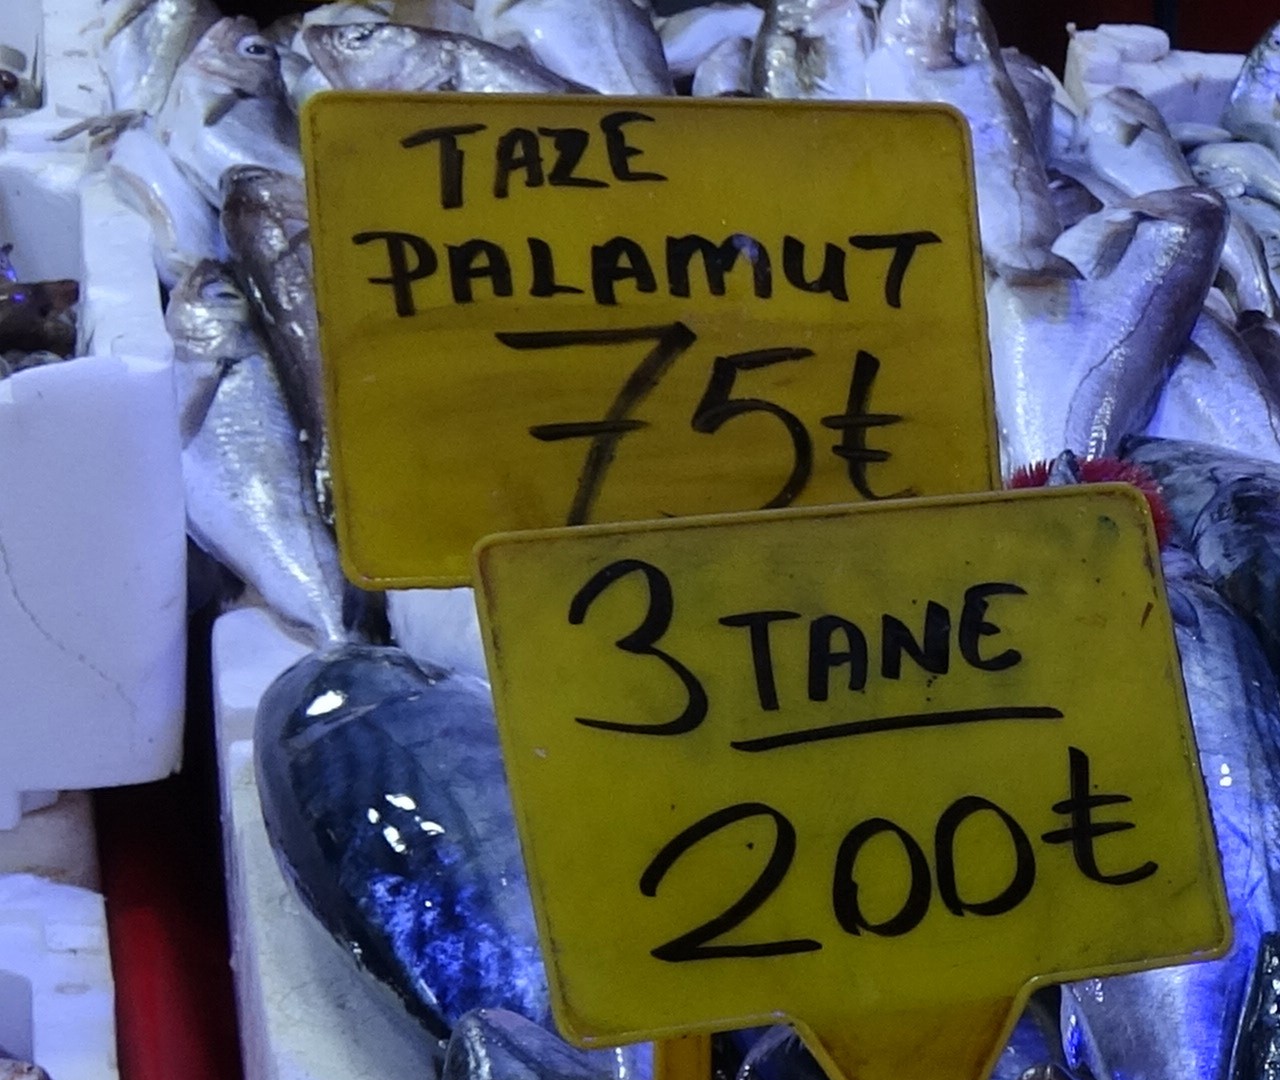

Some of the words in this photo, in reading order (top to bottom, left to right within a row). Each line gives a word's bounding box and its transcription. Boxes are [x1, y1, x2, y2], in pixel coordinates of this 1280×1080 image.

[401, 112, 668, 208] TAZE
[352, 230, 942, 316] PALAMUT
[568, 558, 710, 737] 3
[718, 582, 1028, 712] TANE
